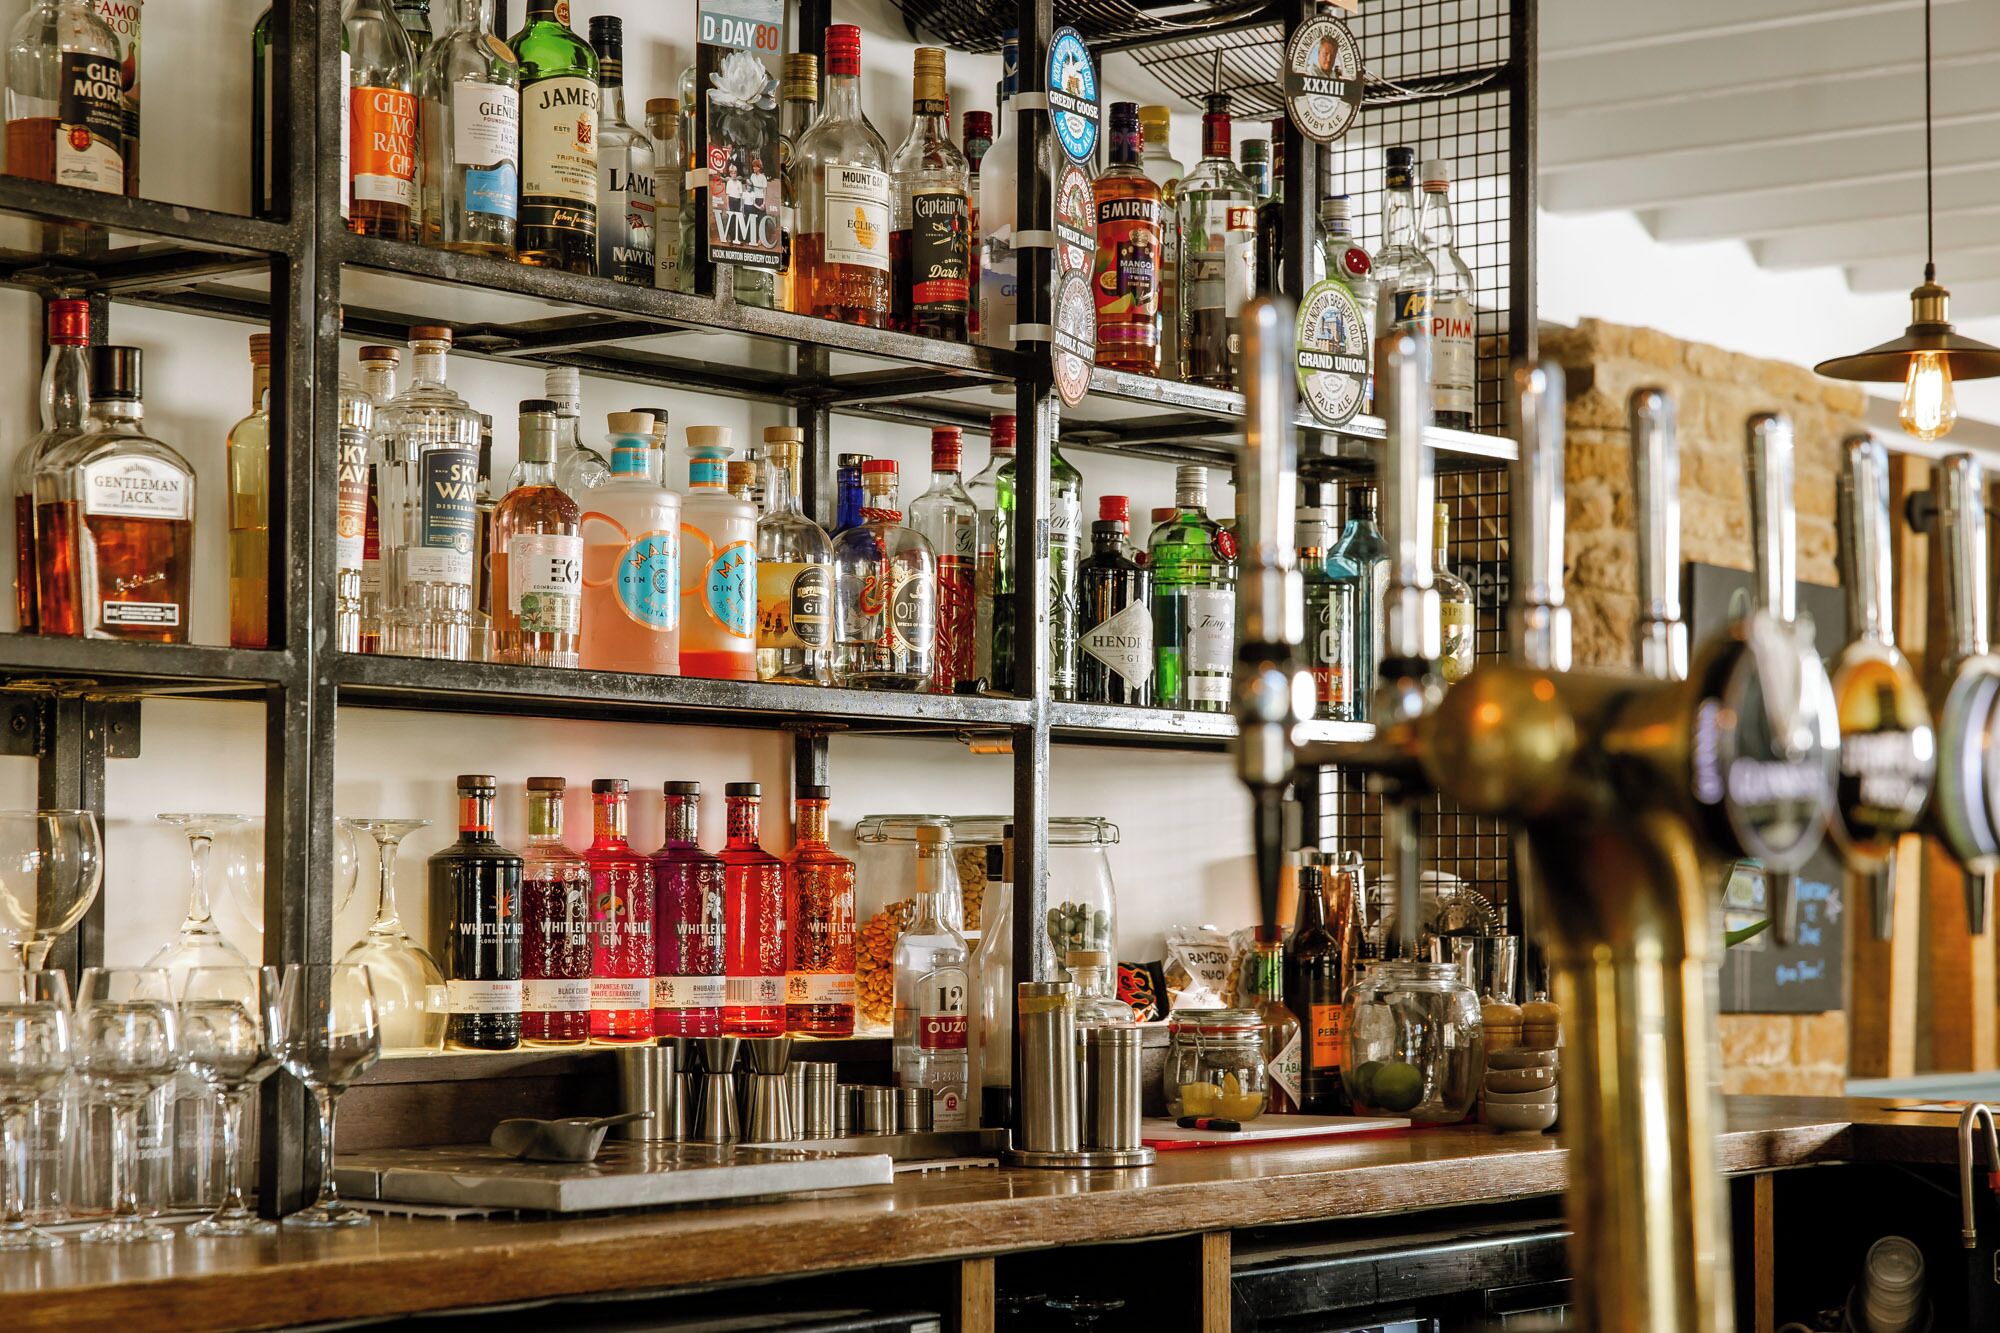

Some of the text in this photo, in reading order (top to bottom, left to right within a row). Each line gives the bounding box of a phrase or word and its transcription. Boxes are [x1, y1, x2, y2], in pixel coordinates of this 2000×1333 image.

[1295, 48, 1307, 67] HOOK
[1302, 25, 1323, 50] NORTON
[1302, 76, 1345, 96] XXXIII
[374, 93, 414, 117] GLEN
[1049, 90, 1099, 119] GREEDY GOOSE
[391, 115, 415, 138] MO
[1303, 111, 1342, 131] RUBY ALE
[374, 132, 409, 154] RAN
[1058, 117, 1095, 154] WINTER ALE
[842, 171, 871, 185] MOUNT
[396, 181, 406, 196] 12
[915, 196, 956, 217] Captain
[1101, 201, 1161, 221] SMIRN
[713, 209, 778, 249] VMC
[847, 219, 881, 232] ECLIPSE
[613, 246, 644, 264] NAVY
[712, 249, 725, 259] HOOK
[726, 251, 744, 261] NORTON
[744, 253, 765, 263] BREWERY
[928, 264, 959, 279] Dark
[1120, 260, 1152, 269] MANGO
[1304, 318, 1316, 342] HOOK
[1310, 294, 1330, 321] NORTON
[1330, 293, 1356, 324] BREWERY
[1055, 330, 1095, 361] DOUBLE STOUT
[1299, 351, 1366, 374] GRAND UNION
[1314, 391, 1352, 415] PALE ALE
[450, 464, 479, 483] SKY
[94, 475, 179, 492] GENTLEMAN
[121, 490, 155, 504] JACK
[628, 541, 678, 571] MAL
[712, 584, 732, 592] GIN
[895, 601, 936, 620] OPI
[1199, 613, 1227, 631] Tanq
[1127, 654, 1140, 663] GI
[459, 922, 511, 935] WHITLEY
[540, 921, 586, 933] WHITLEY
[676, 922, 719, 935] WHITLEY
[809, 922, 851, 933] WHITLEY
[572, 935, 586, 946] GIN
[602, 934, 623, 946] GIN
[838, 934, 852, 944] GIN
[558, 987, 575, 995] BLACK
[937, 985, 964, 1011] 12
[927, 1020, 967, 1034] OUZO
[1278, 1062, 1301, 1074] TABA
